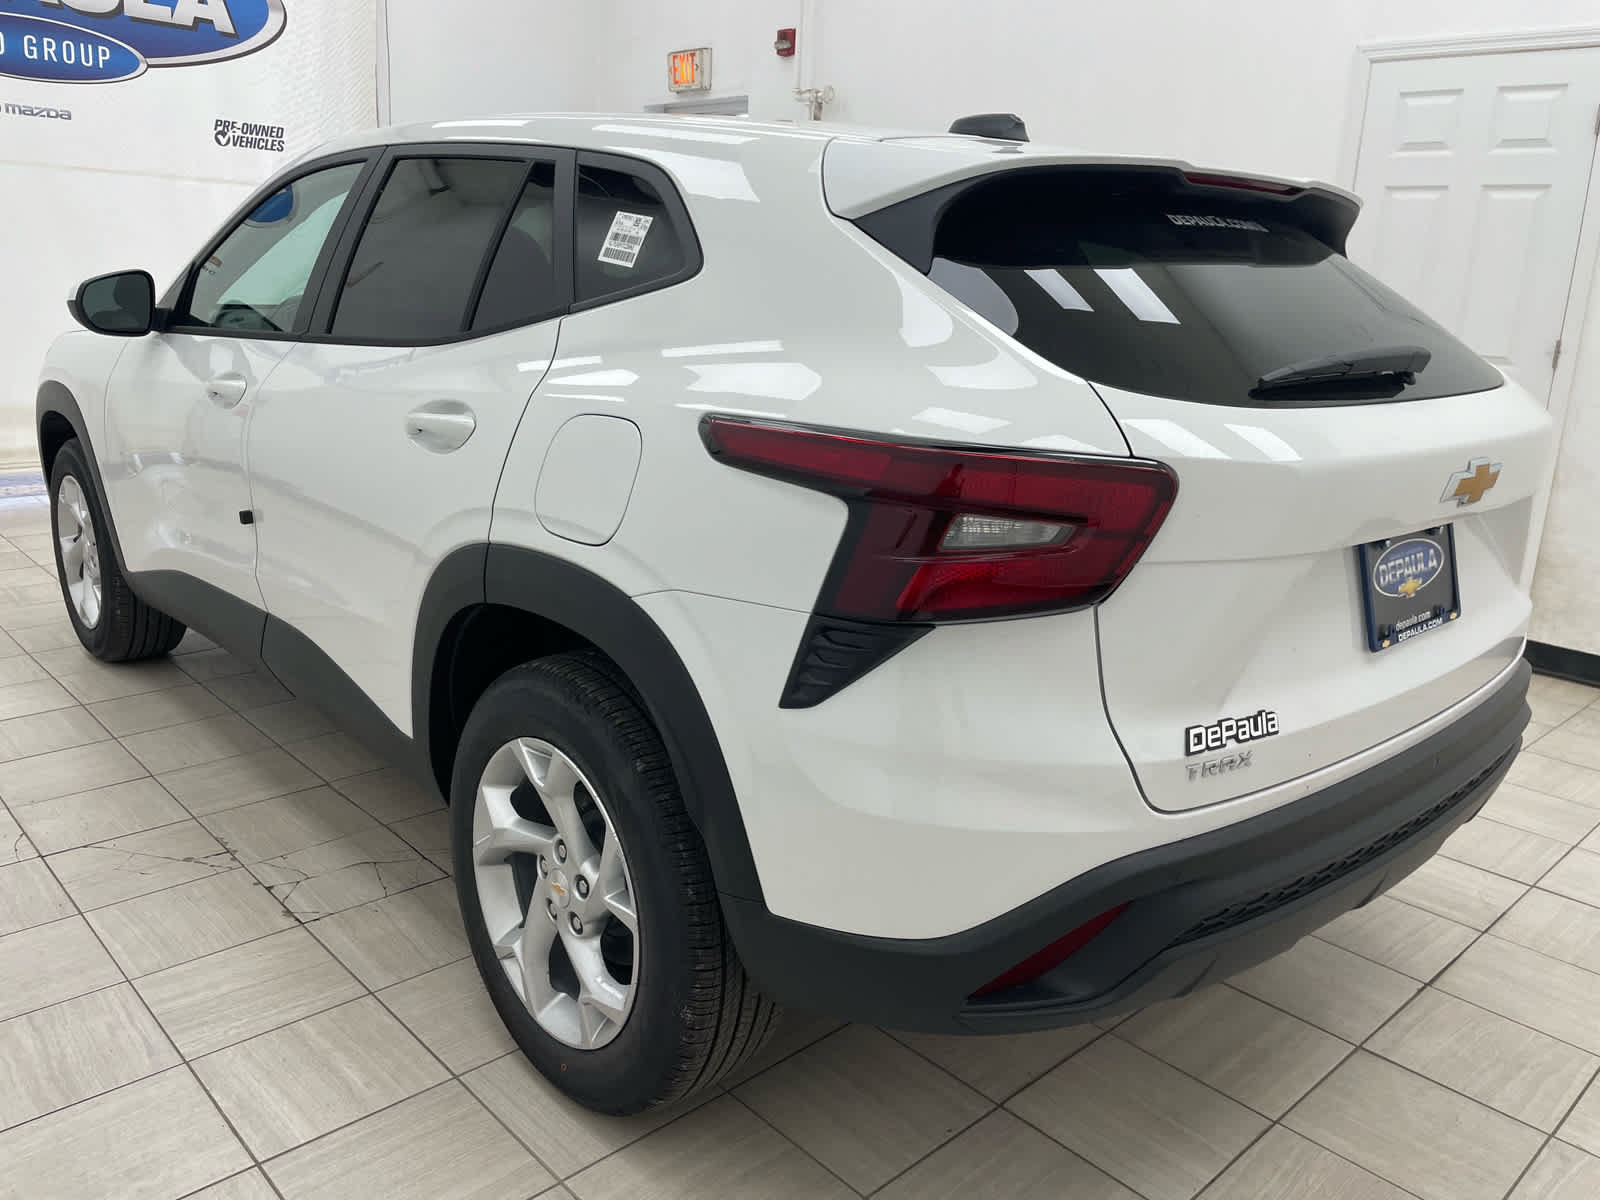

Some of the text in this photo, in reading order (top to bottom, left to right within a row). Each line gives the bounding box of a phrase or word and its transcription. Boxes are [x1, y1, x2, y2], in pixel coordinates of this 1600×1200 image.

[23, 35, 110, 68] GROUP
[672, 53, 696, 85] EXIT
[214, 119, 284, 138] PRE-OWNED
[232, 135, 285, 152] VEHICLES
[1379, 549, 1437, 586] DEPAULA
[1185, 710, 1279, 756] DePaula
[1185, 750, 1253, 781] TRAX
